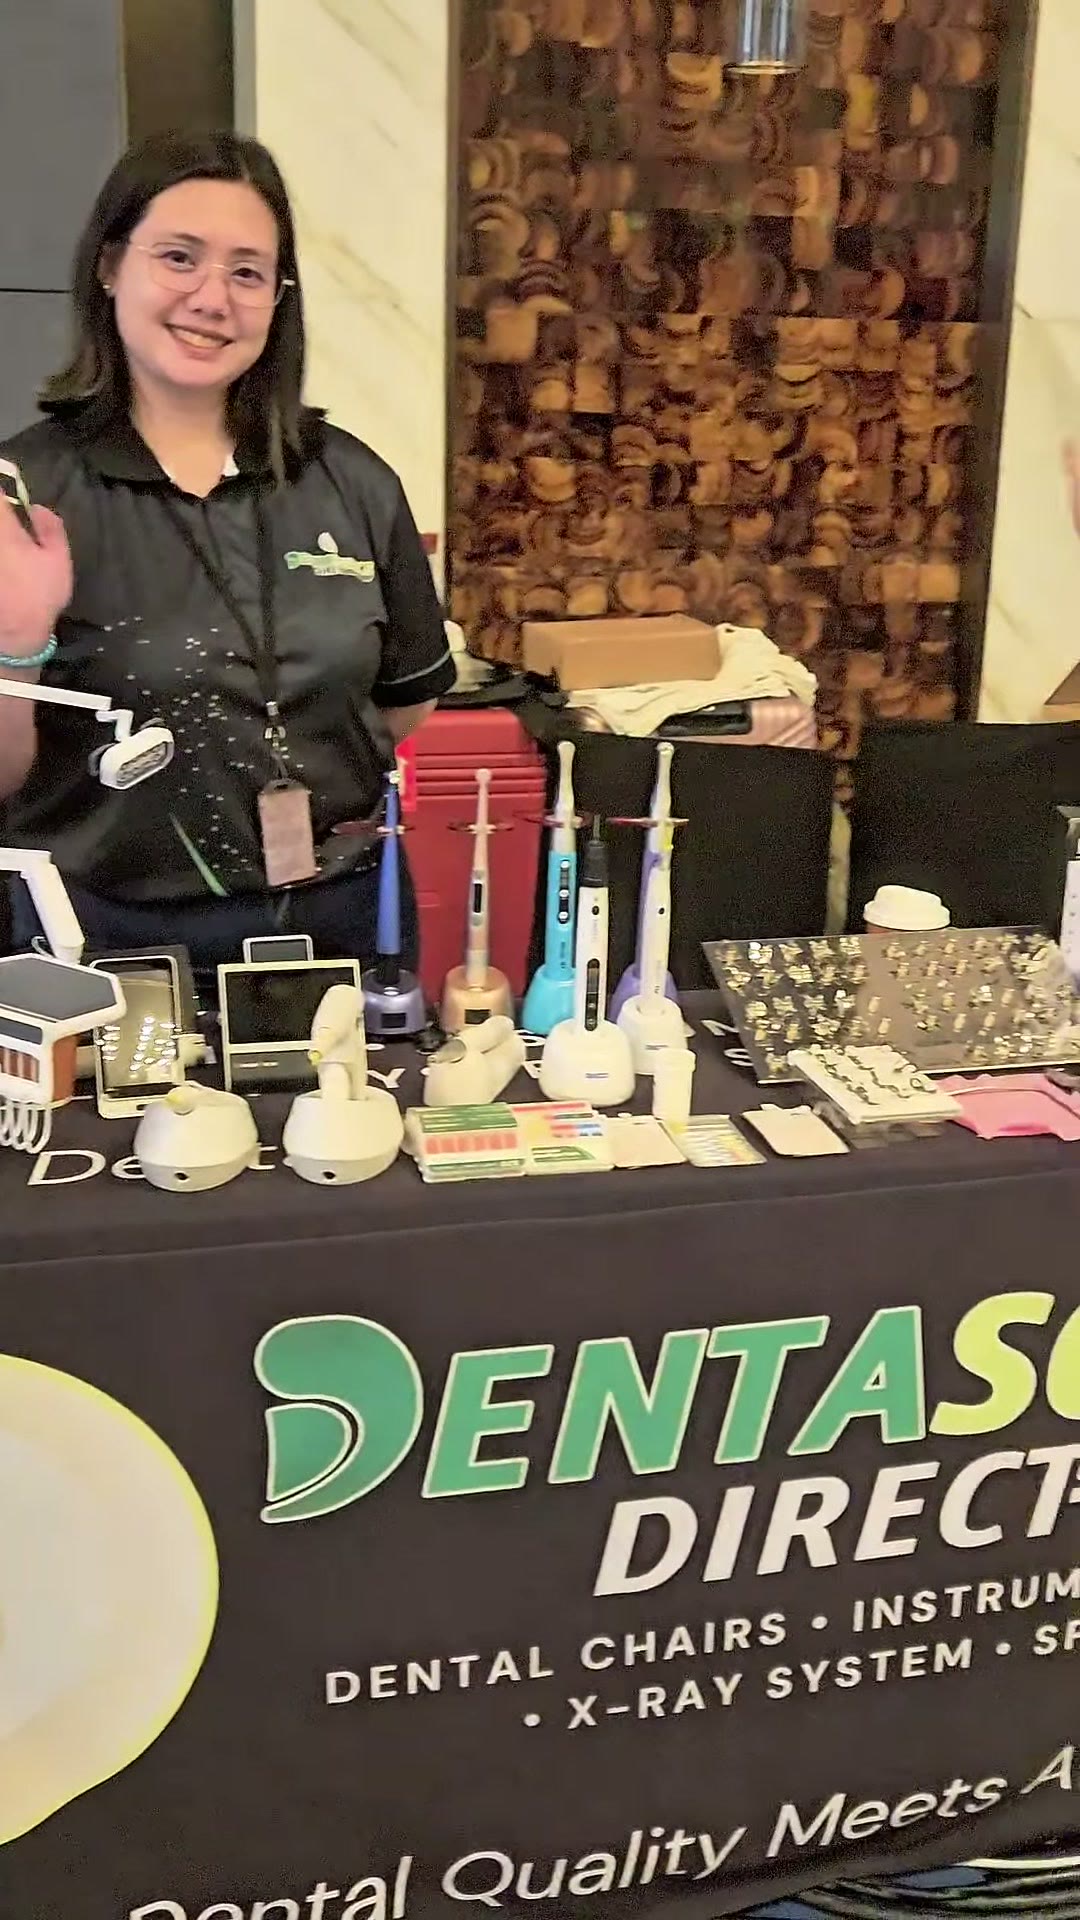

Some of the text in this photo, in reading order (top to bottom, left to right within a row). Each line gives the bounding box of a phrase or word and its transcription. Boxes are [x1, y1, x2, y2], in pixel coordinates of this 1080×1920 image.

[325, 1567, 1080, 1705] DENTAL CHAIRS INSTRUM
[567, 1672, 743, 1730] X-RAY
[766, 1637, 973, 1699] SYSTEM
[442, 1826, 747, 1907] Quality
[766, 1776, 1008, 1858] Meets
